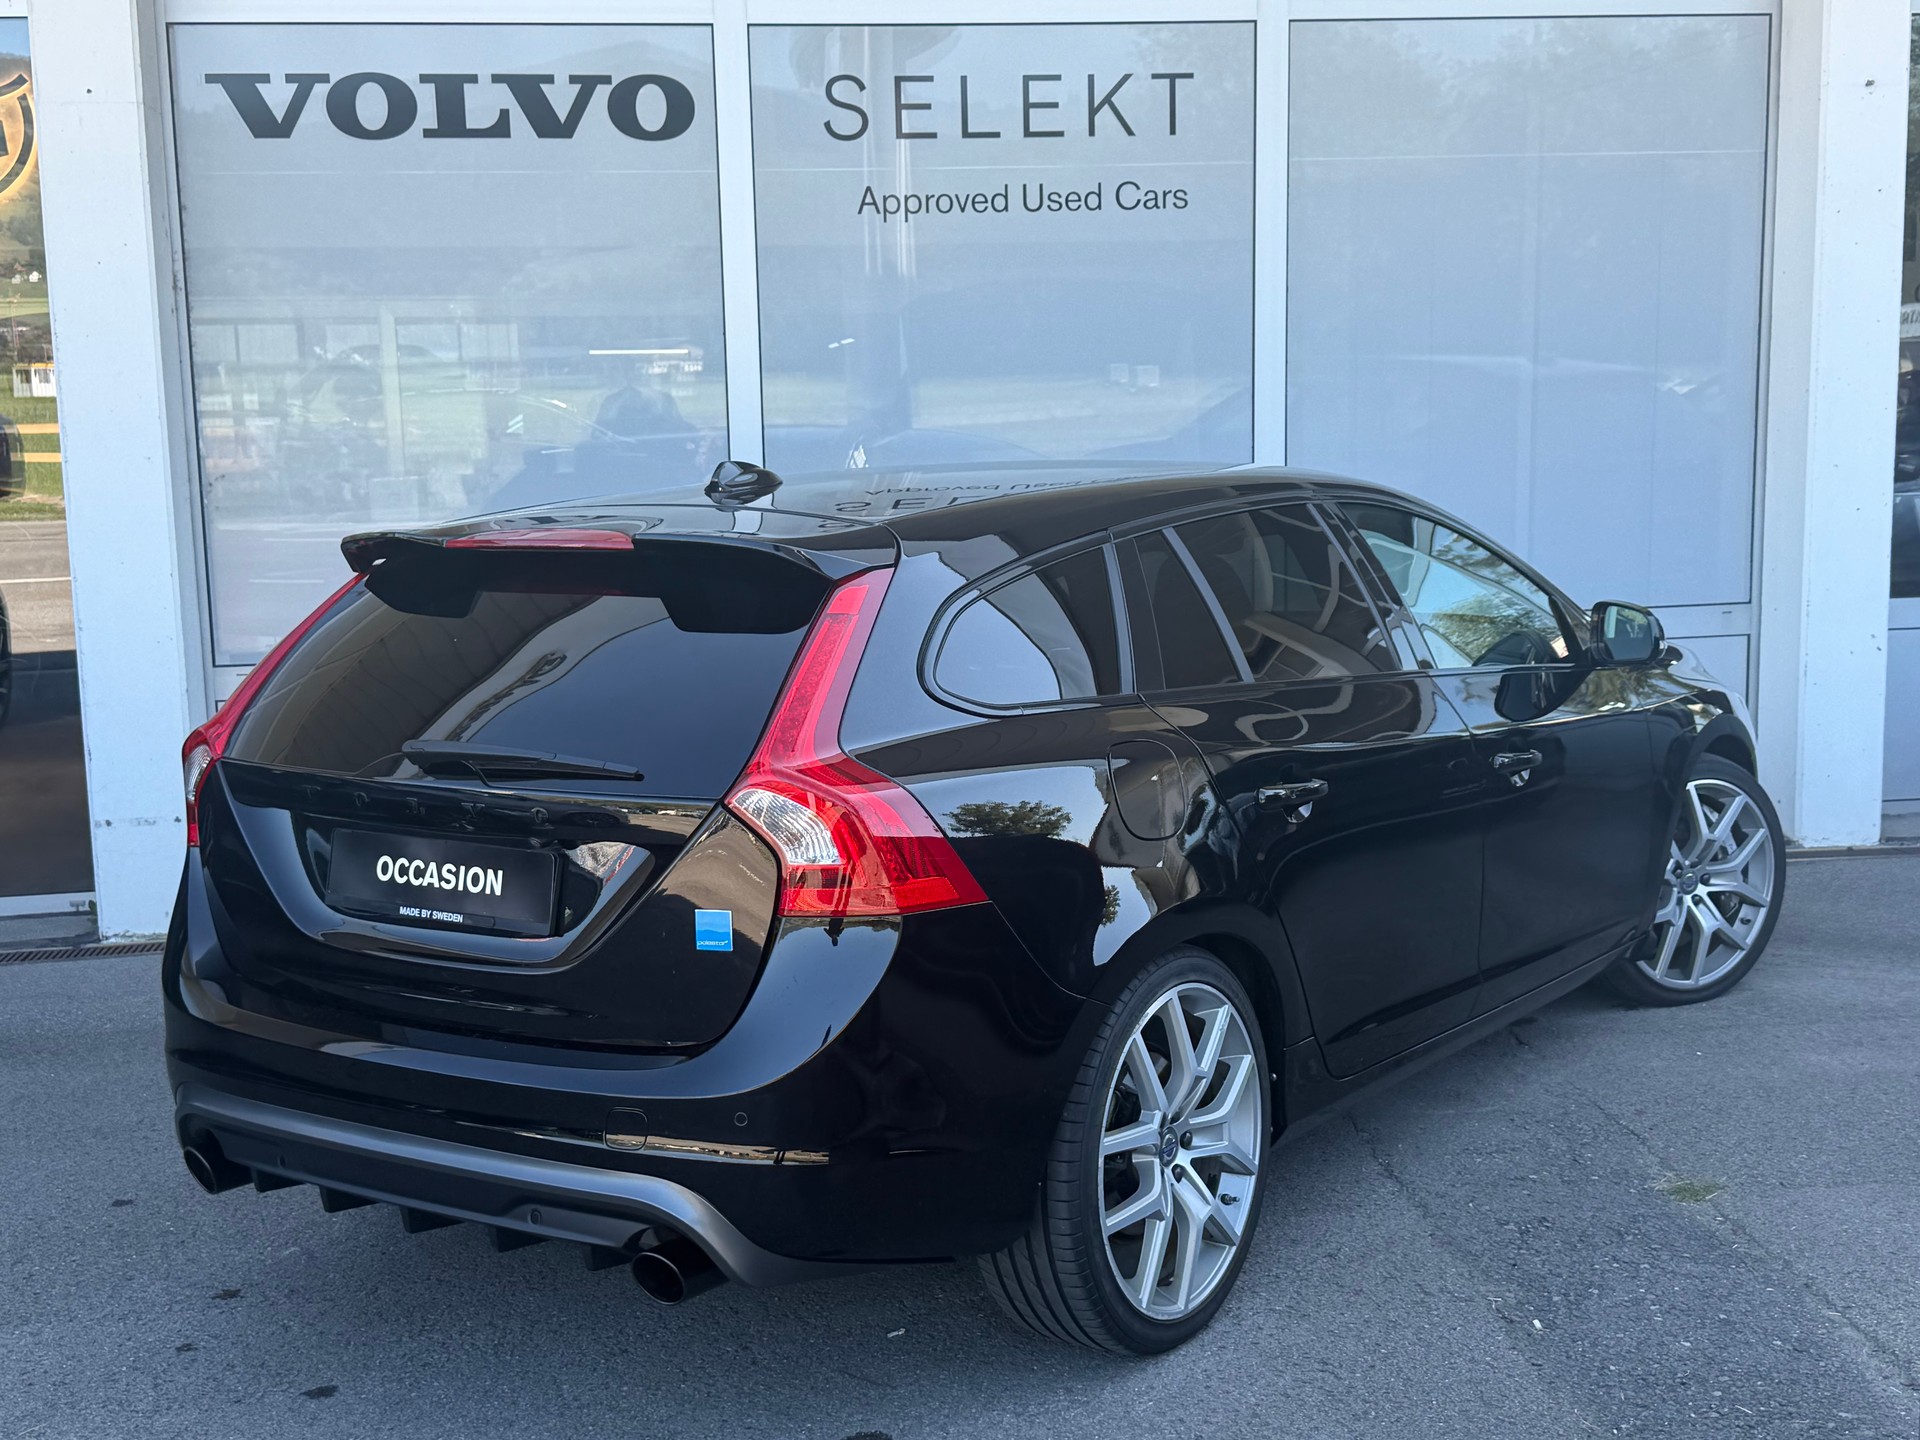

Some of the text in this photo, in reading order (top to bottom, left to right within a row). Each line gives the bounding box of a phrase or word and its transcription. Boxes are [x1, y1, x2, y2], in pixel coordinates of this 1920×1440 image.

[204, 71, 696, 142] VOLVO
[823, 72, 1195, 142] SELEKT
[857, 180, 1190, 223] Approved Used Cars
[376, 854, 504, 896] OCCASION
[399, 905, 464, 923] MADE BY SWEDEN
